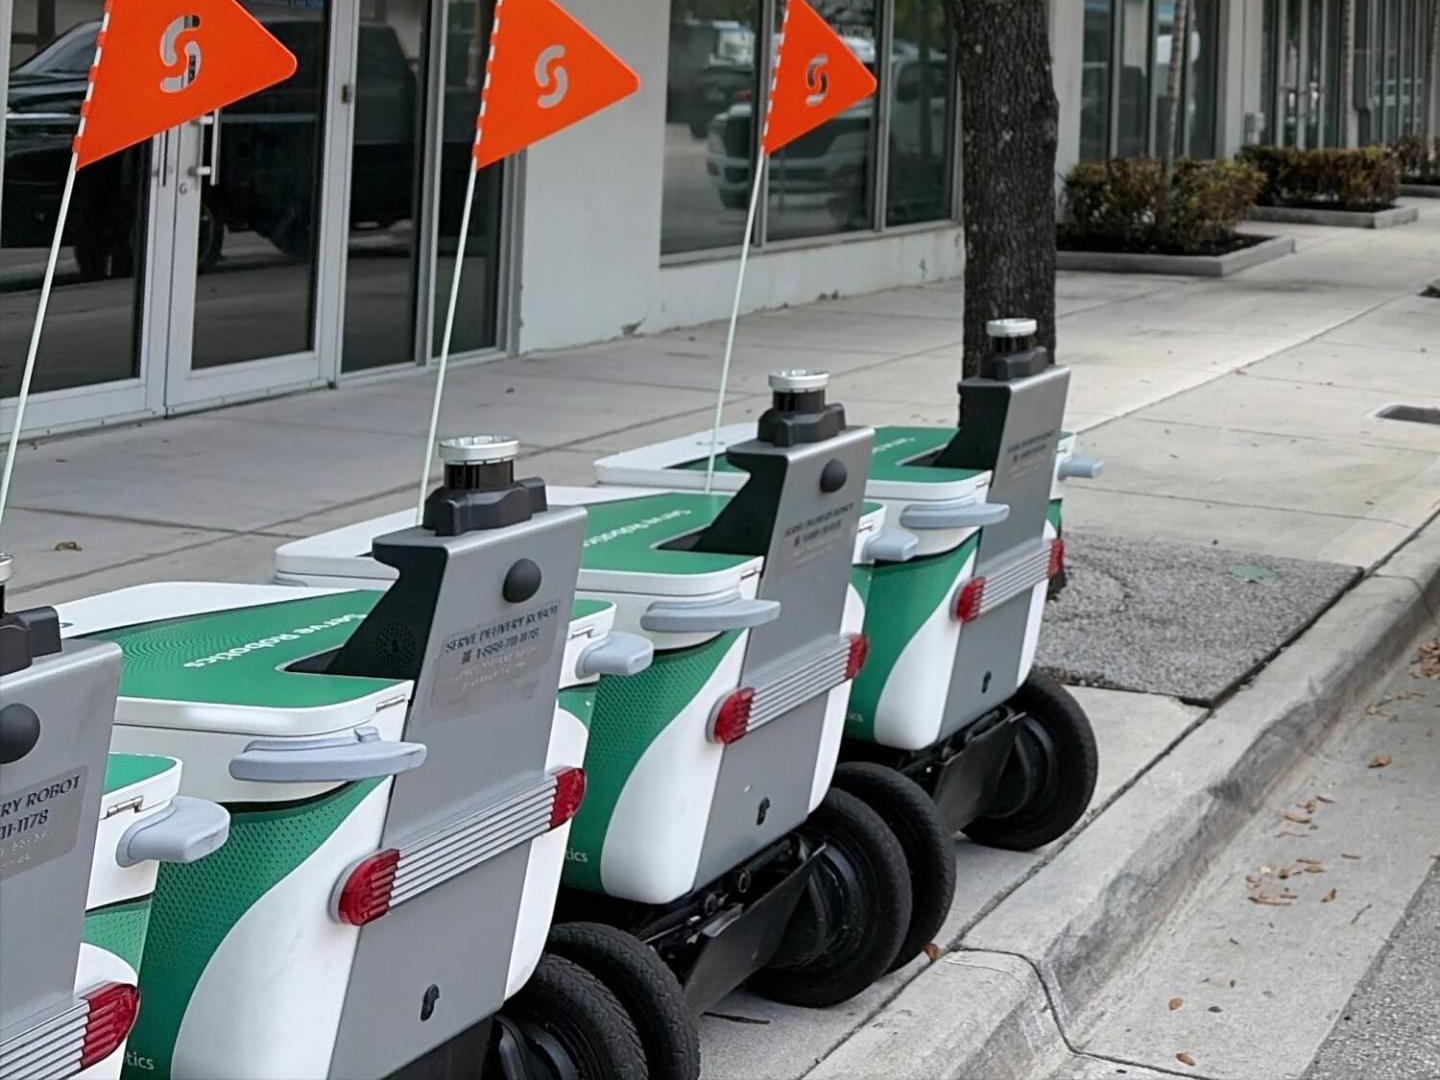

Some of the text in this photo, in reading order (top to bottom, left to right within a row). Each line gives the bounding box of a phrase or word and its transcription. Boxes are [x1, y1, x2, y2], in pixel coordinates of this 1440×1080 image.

[0, 775, 80, 818] RY ROBOT
[125, 1050, 155, 1070] tics
